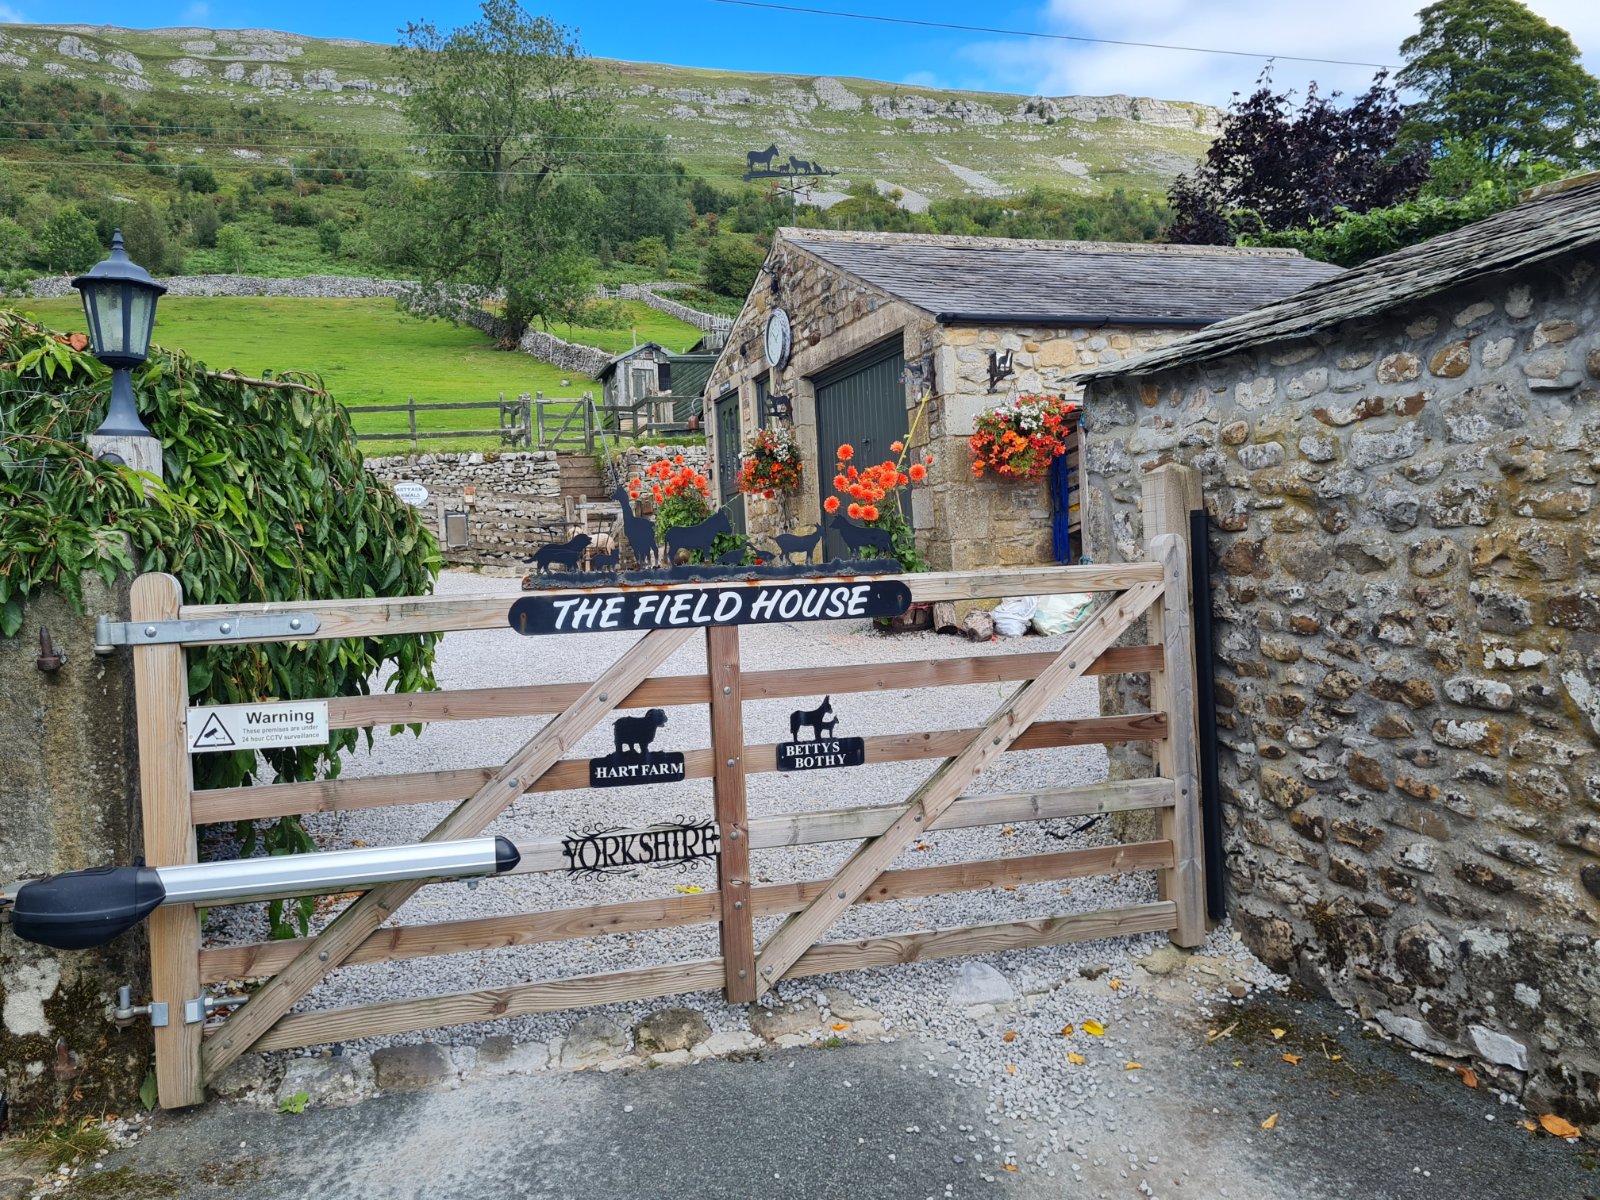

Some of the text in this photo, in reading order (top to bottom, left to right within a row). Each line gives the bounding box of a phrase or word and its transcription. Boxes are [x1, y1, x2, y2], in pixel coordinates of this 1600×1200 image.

[553, 585, 871, 630] THE FIELD HOUSE
[246, 710, 314, 724] Warning
[261, 726, 289, 734] premises
[794, 753, 847, 769] BOTHY
[595, 762, 684, 779] HART FARM
[561, 825, 717, 871] YORKSHIRE
